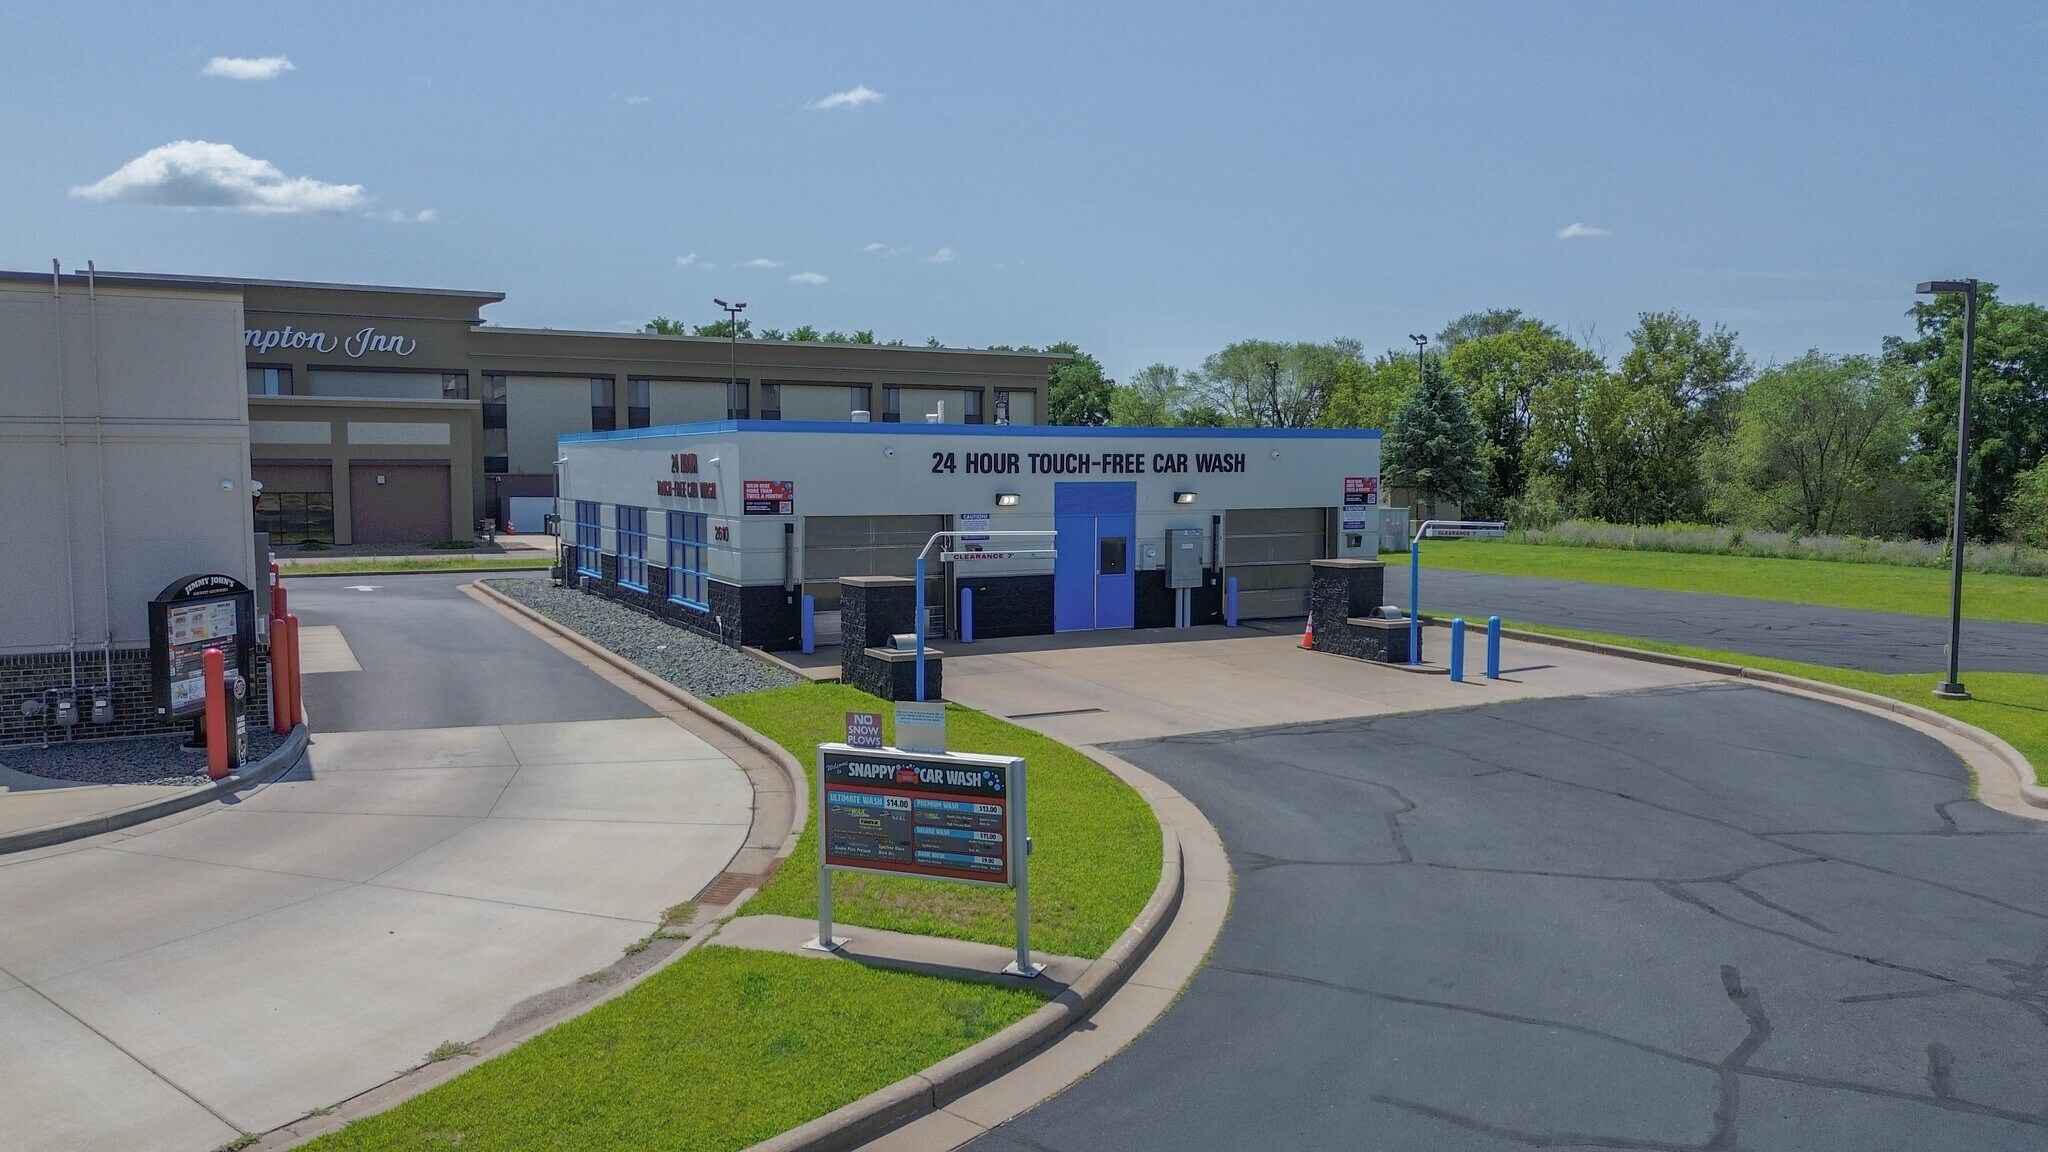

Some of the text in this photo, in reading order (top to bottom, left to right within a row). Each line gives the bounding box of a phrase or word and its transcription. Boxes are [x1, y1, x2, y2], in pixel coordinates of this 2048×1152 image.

[345, 327, 416, 358] Inn
[671, 453, 679, 473] 24
[932, 452, 1246, 474] 24 HOUR TOUCH-FREE CAR WASH
[184, 576, 235, 596] JIMMY JOHN'S
[854, 714, 873, 725] NO
[848, 726, 879, 735] SNOW
[847, 736, 881, 746] PLOWS
[848, 762, 982, 787] SNAPPY CAR WASH
[830, 794, 882, 806] ULTIMATE WASH
[886, 799, 909, 809] $14.00
[916, 800, 959, 810] PREMIUM WASH
[979, 805, 998, 814] $13.00
[980, 833, 997, 841] $11.00
